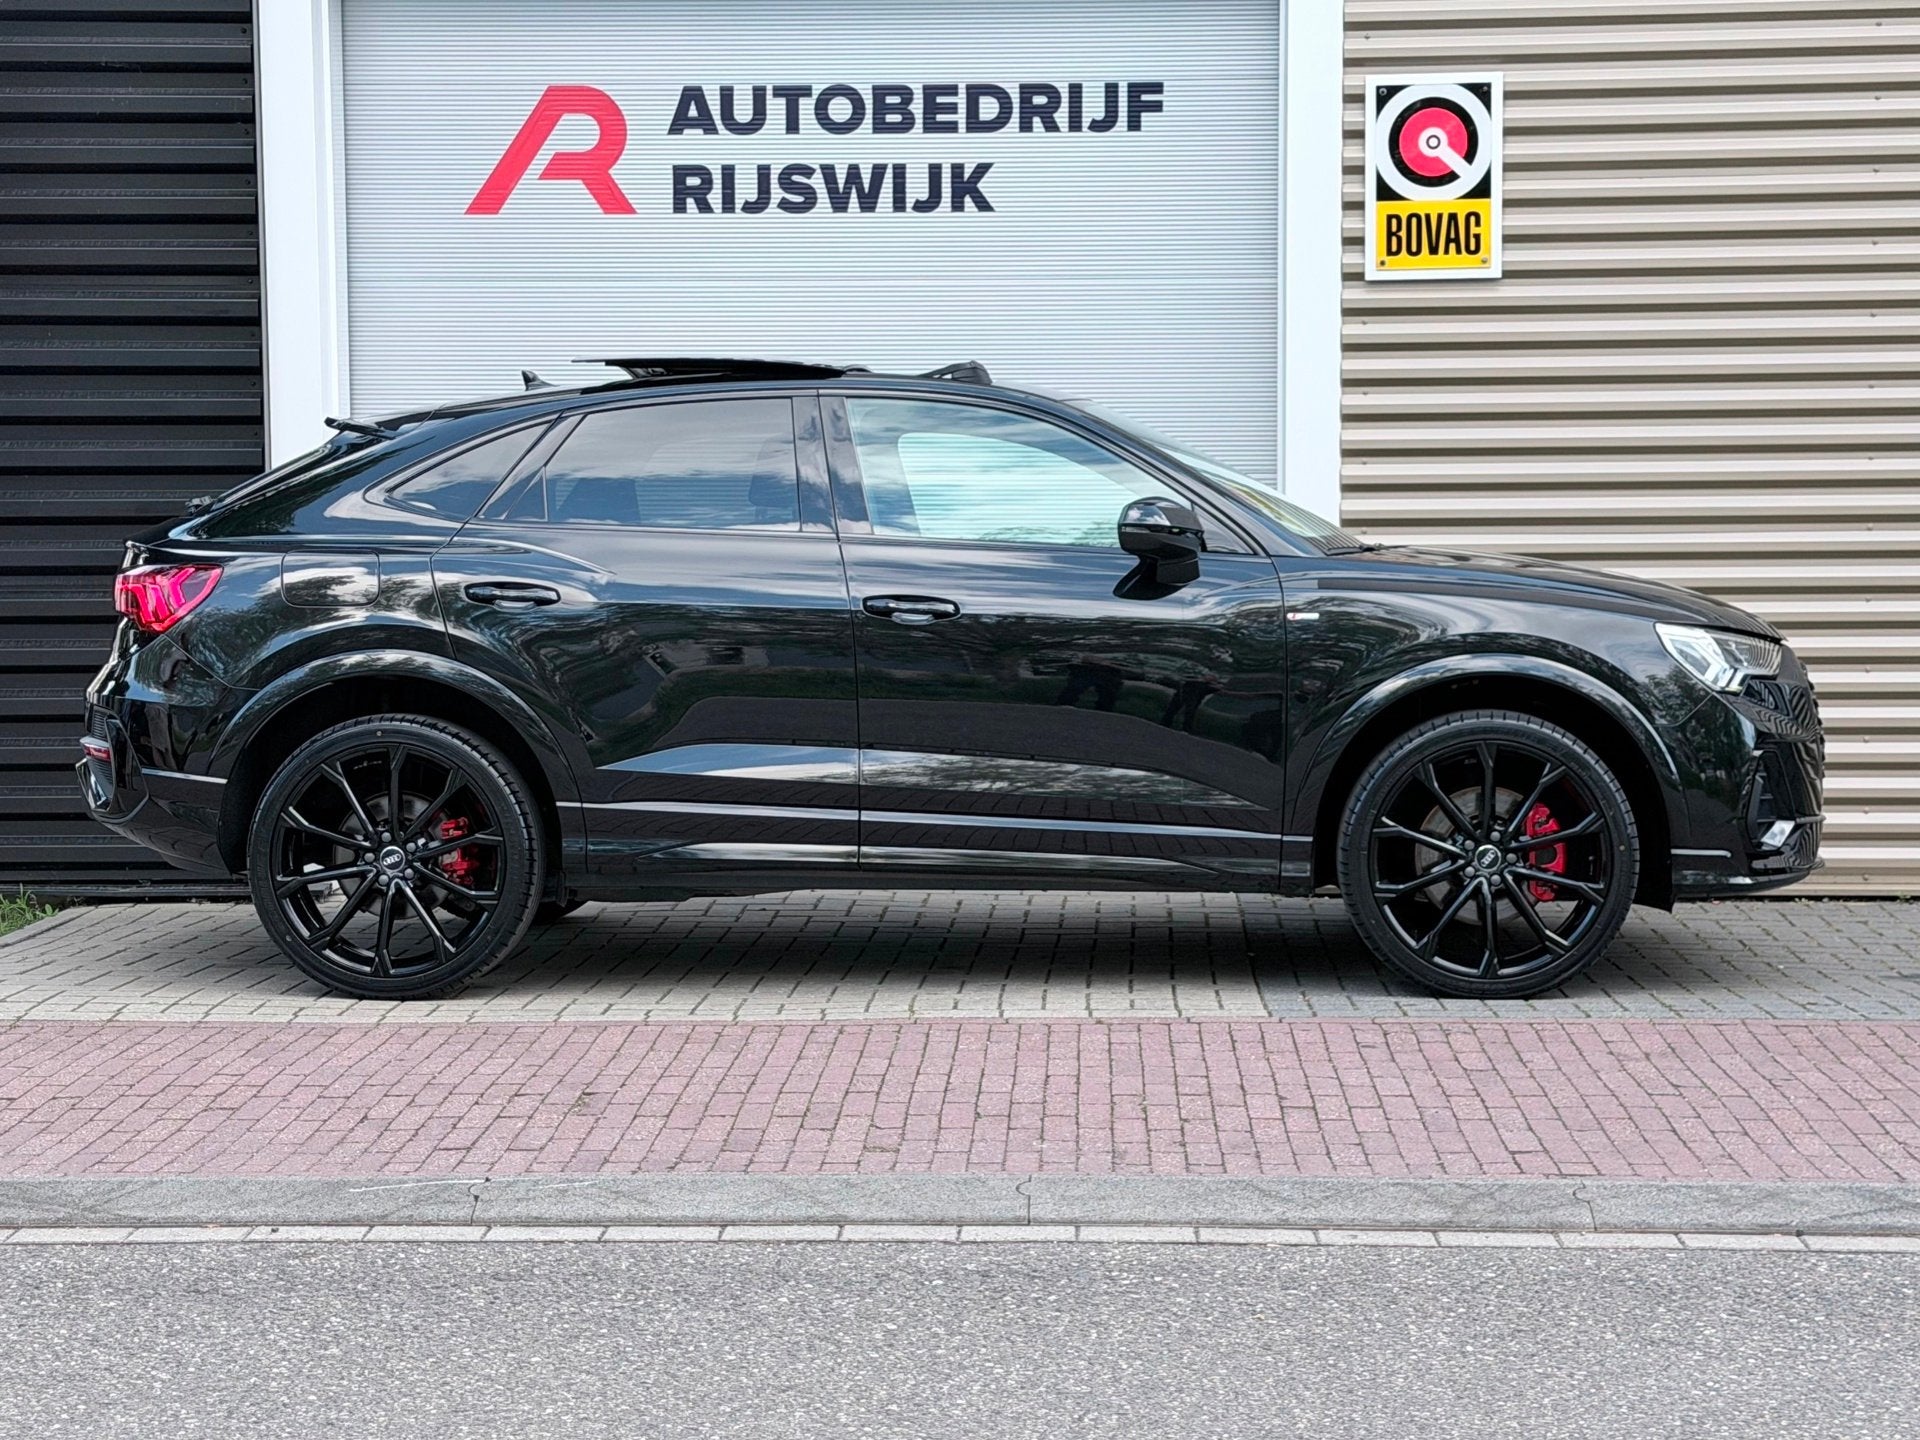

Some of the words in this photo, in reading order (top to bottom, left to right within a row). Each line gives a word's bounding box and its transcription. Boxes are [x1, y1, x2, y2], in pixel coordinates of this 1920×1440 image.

[668, 82, 1164, 135] AUTOBEDRIJF
[672, 162, 995, 214] RIJSWIJK
[1386, 211, 1481, 257] BOVAG
